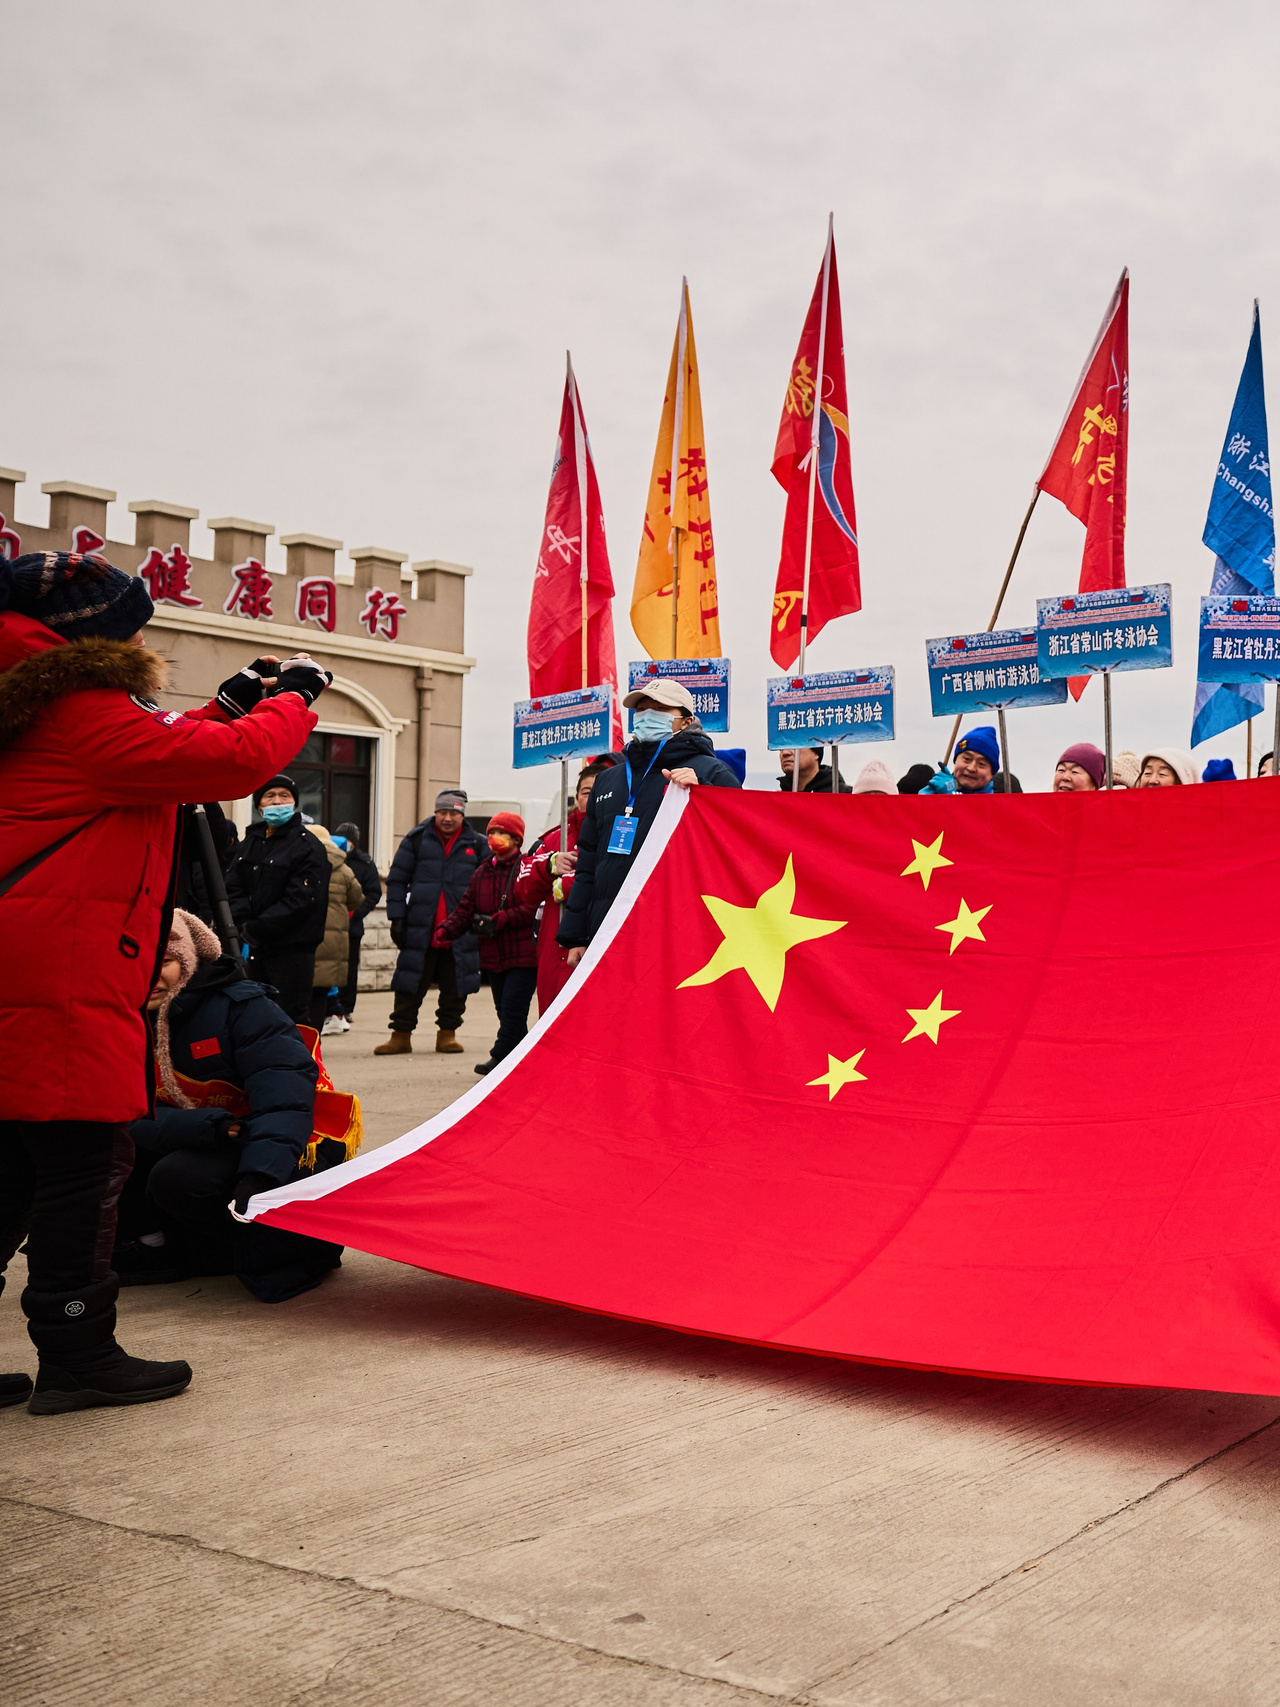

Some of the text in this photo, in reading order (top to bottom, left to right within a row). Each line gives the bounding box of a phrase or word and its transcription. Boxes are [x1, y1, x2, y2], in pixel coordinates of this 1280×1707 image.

[1226, 431, 1270, 478] 浙江
[1048, 622, 1160, 658] 浙江省常山市冬泳协会
[941, 662, 1052, 696] 广西省柳州市游泳协
[777, 700, 884, 732] 黑龙江省东宁市冬泳协会
[520, 717, 602, 751] 黑龙江省牡丹江市冬泳协会
